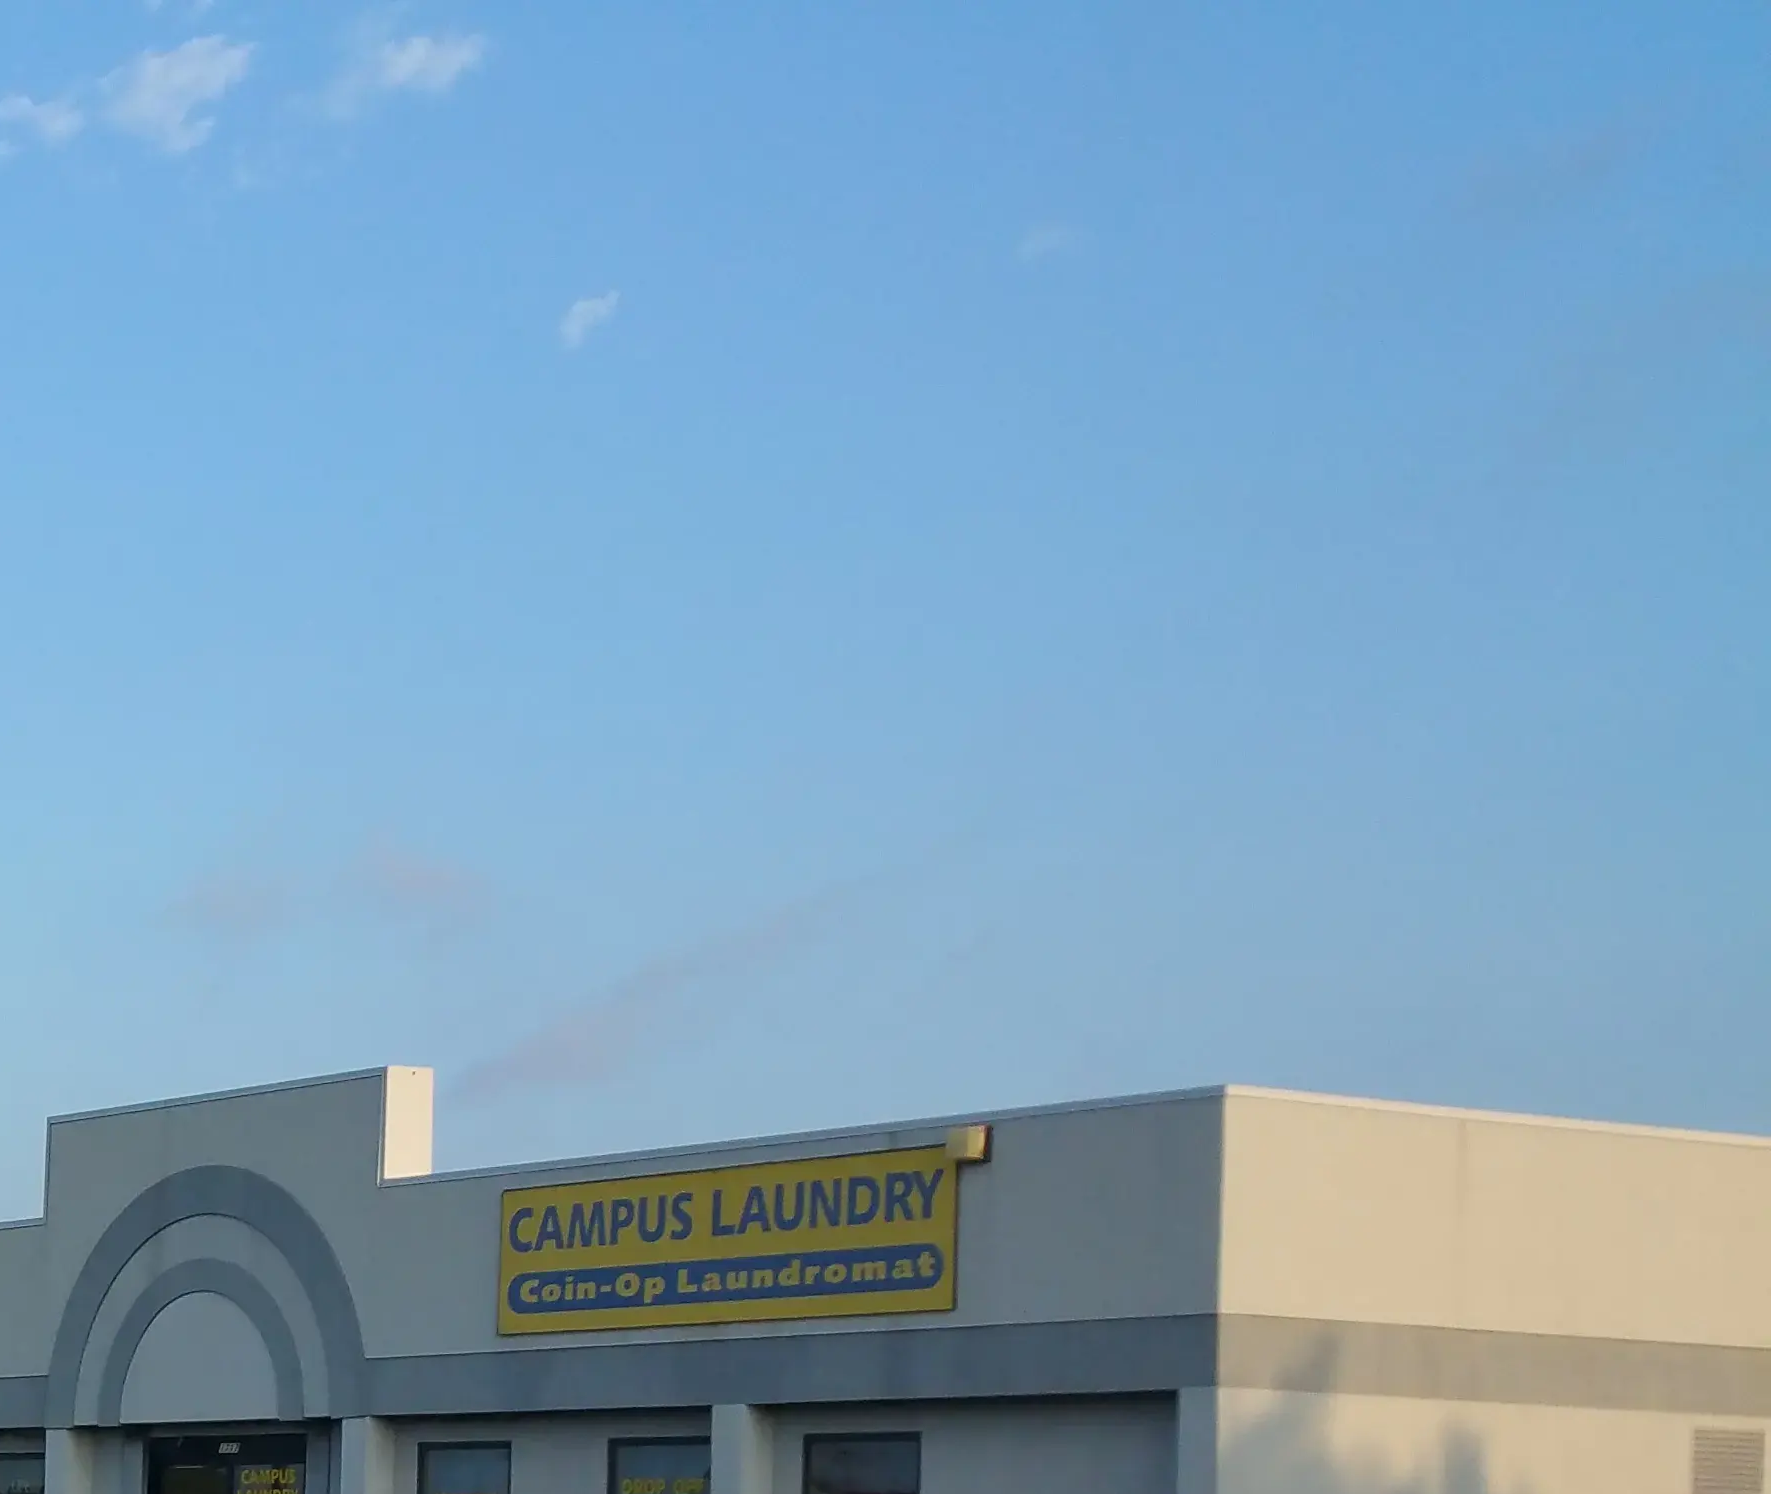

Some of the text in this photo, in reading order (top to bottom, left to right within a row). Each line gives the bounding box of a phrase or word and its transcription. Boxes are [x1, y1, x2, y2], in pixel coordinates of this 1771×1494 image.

[508, 1168, 944, 1253] CAMPUS LAUNDRY
[519, 1250, 937, 1306] Coin-Op Laundromat
[241, 1469, 297, 1484] CAMPUS
